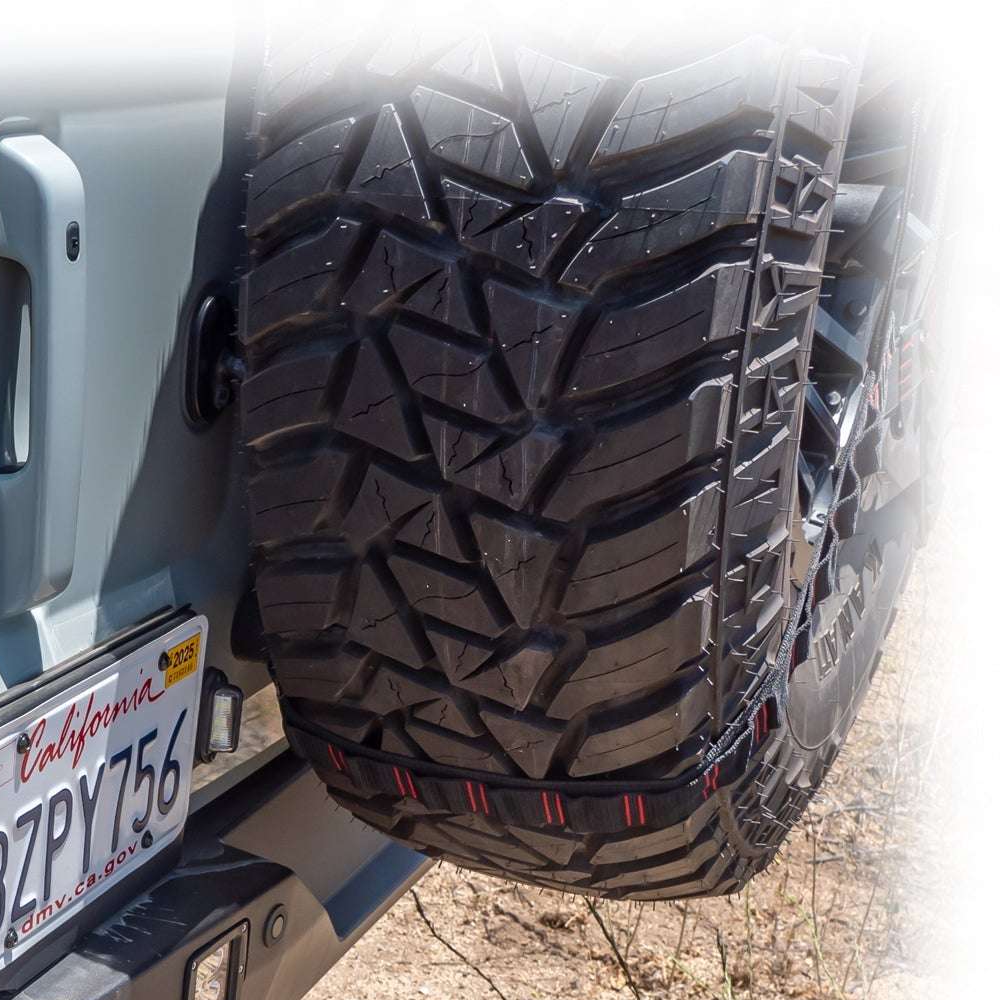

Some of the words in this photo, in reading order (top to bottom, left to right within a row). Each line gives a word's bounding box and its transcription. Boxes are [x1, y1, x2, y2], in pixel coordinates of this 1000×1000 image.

[173, 642, 195, 668] 2025
[20, 668, 165, 783] California
[21, 840, 138, 935] dmv.ca.gov
